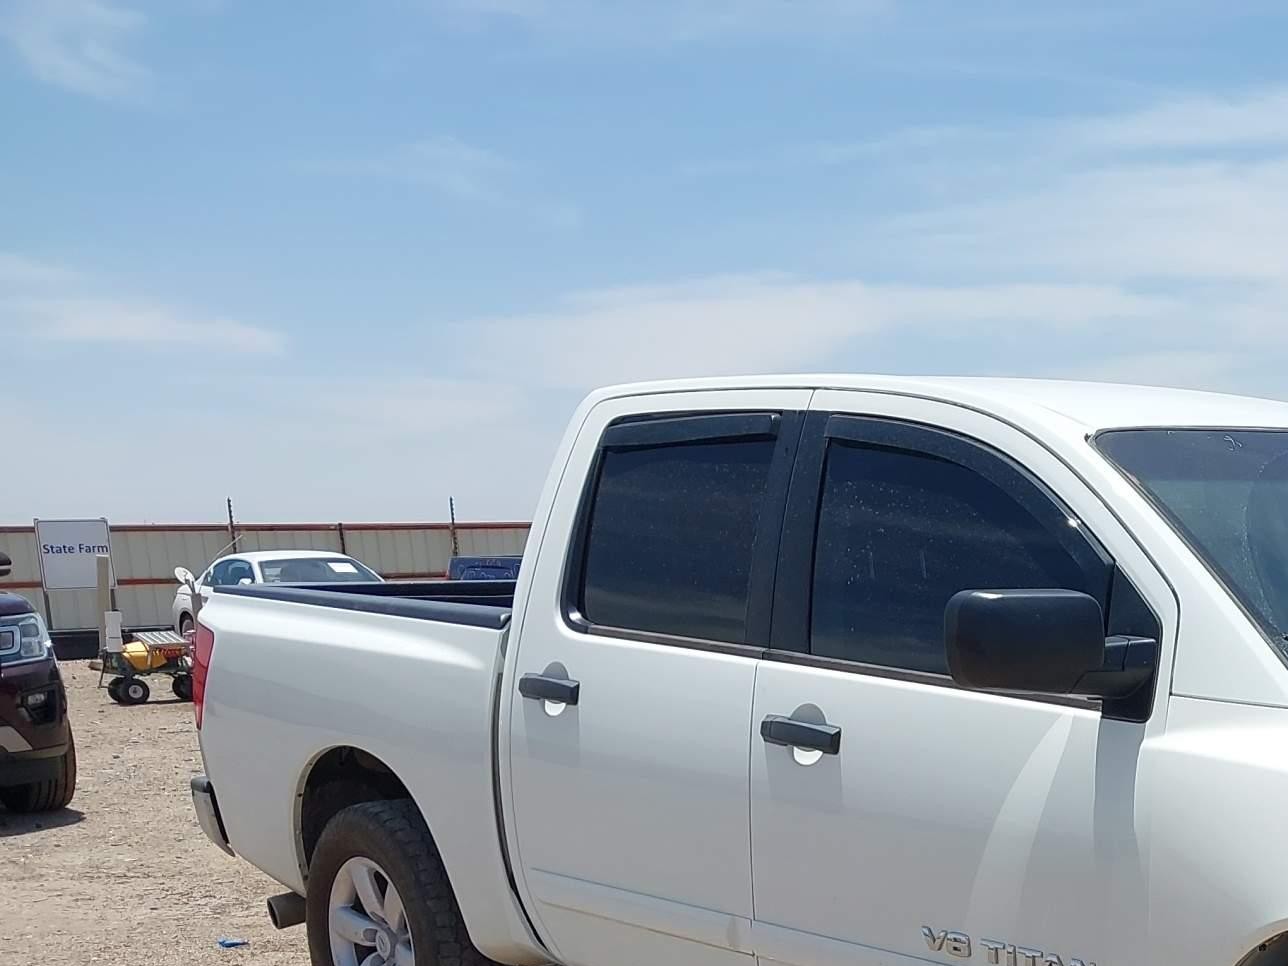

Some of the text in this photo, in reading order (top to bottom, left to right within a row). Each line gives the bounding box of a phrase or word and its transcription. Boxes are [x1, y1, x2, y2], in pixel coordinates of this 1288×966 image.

[42, 543, 109, 554] State Farm
[921, 925, 972, 958] V8
